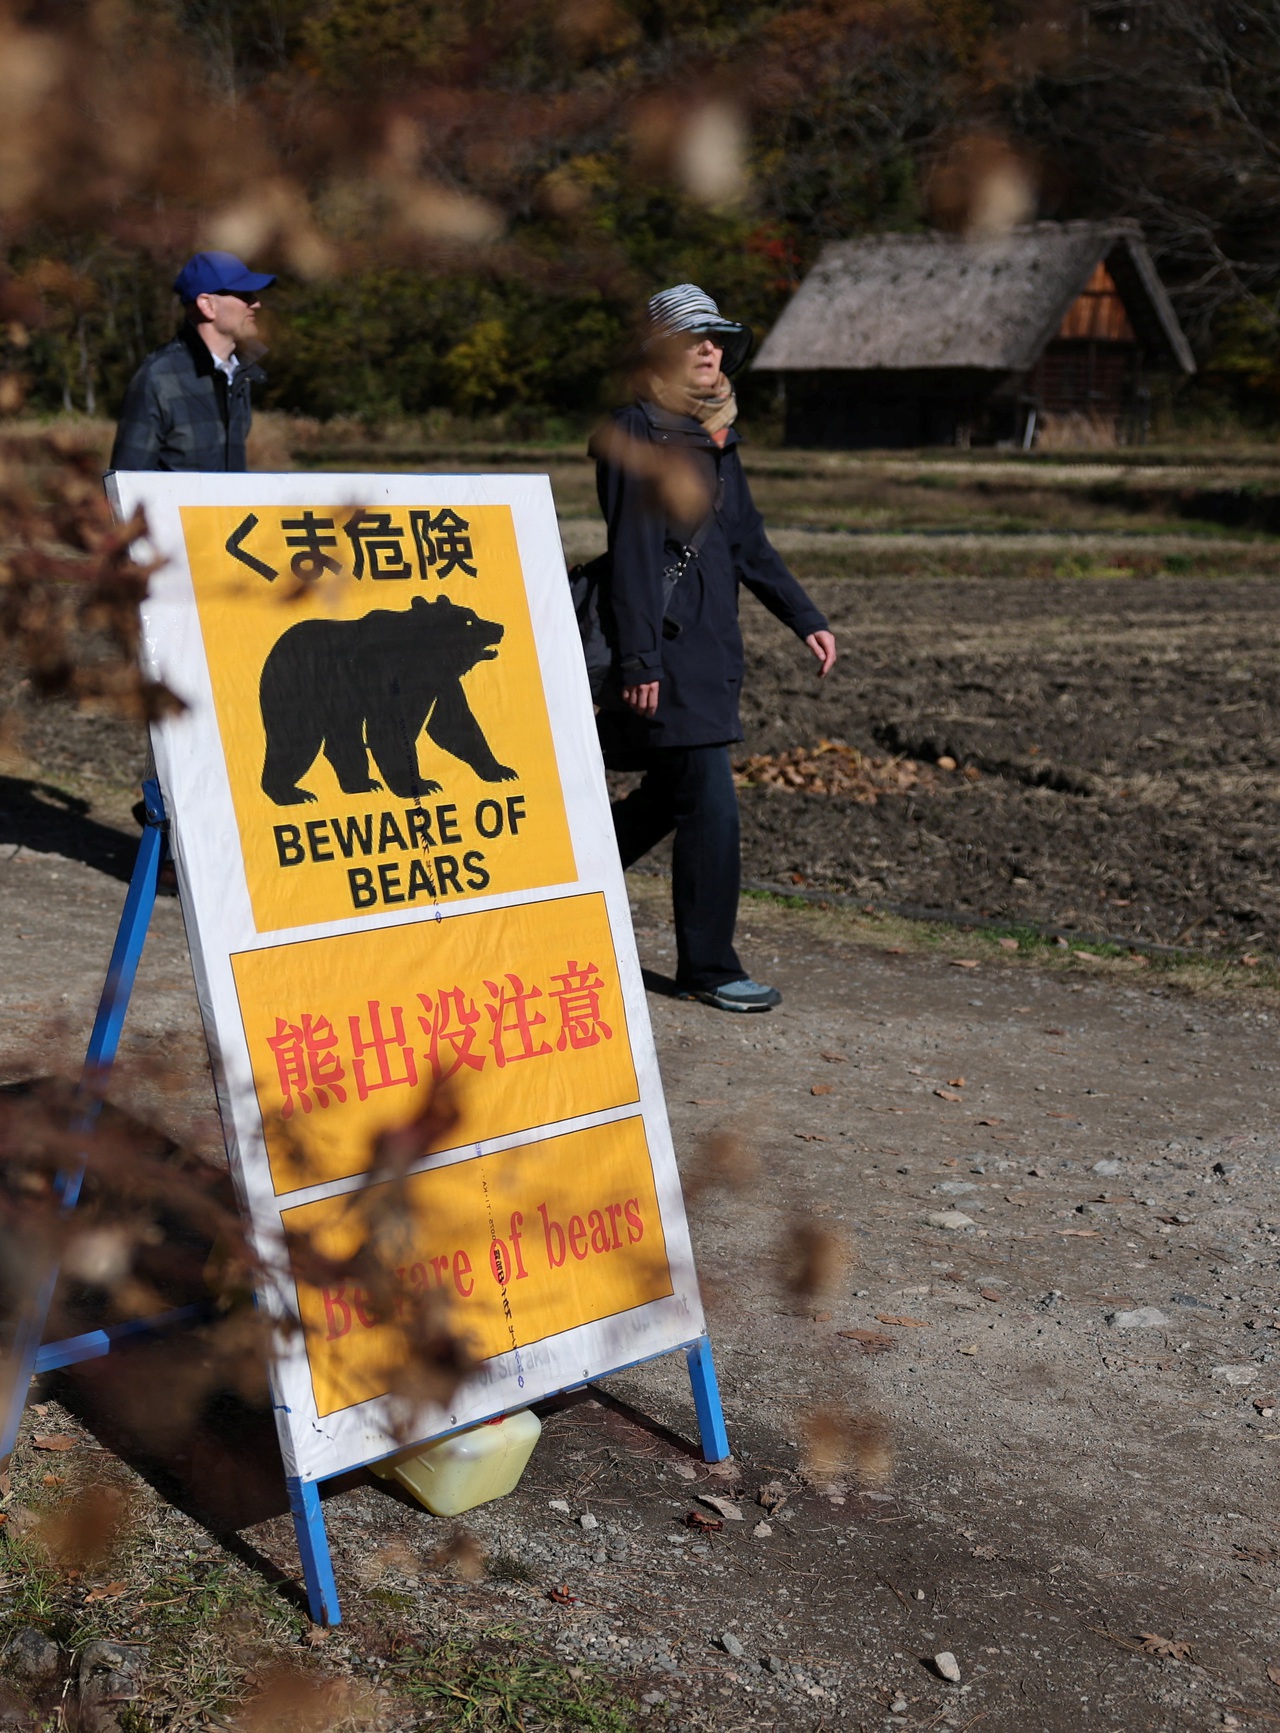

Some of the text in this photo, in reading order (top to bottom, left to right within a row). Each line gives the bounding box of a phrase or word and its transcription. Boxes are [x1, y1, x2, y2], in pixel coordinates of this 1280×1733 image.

[225, 507, 478, 582] くま危険
[272, 795, 527, 868] BEWARE OF
[347, 850, 491, 909] BEARS
[266, 960, 613, 1119] 熊出没注意
[489, 1211, 528, 1286] of
[537, 1197, 644, 1270] bears
